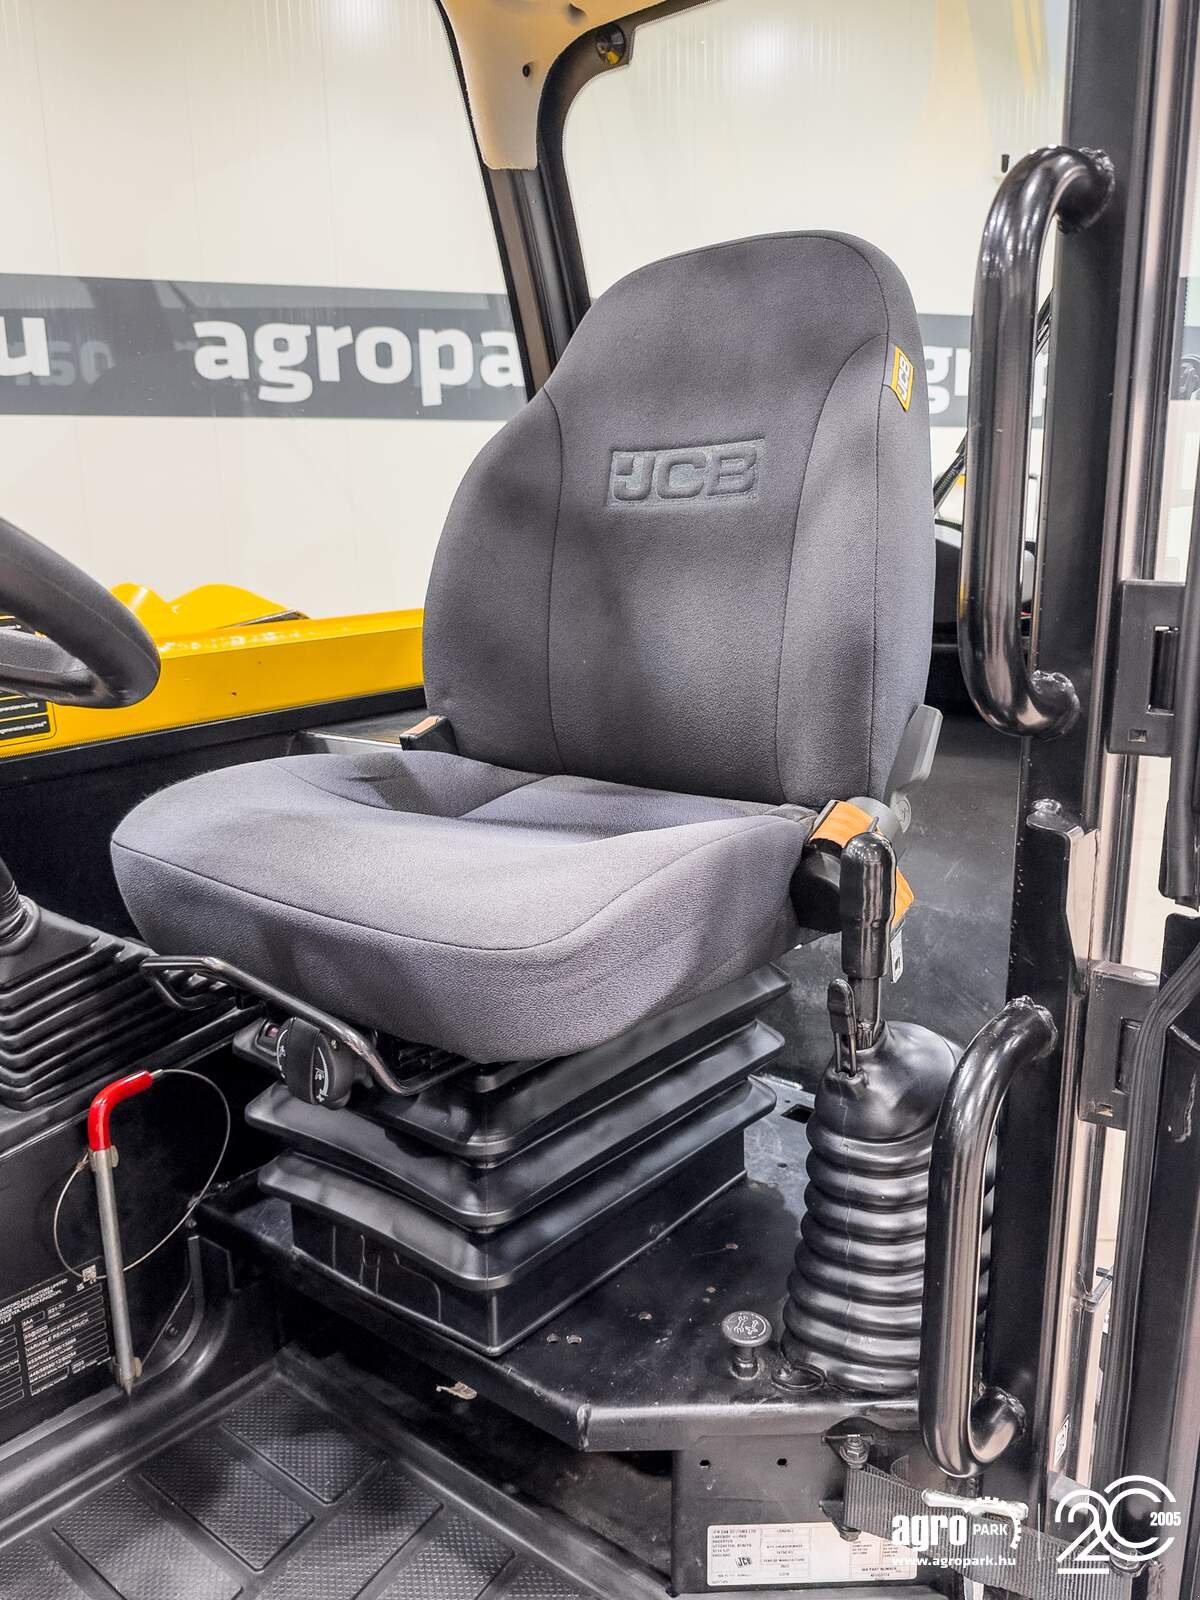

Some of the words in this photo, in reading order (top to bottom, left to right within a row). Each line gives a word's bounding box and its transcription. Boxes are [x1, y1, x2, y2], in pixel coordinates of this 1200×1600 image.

[896, 355, 910, 401] JCB
[613, 444, 757, 501] JCB
[72, 1318, 89, 1329] TRUCK
